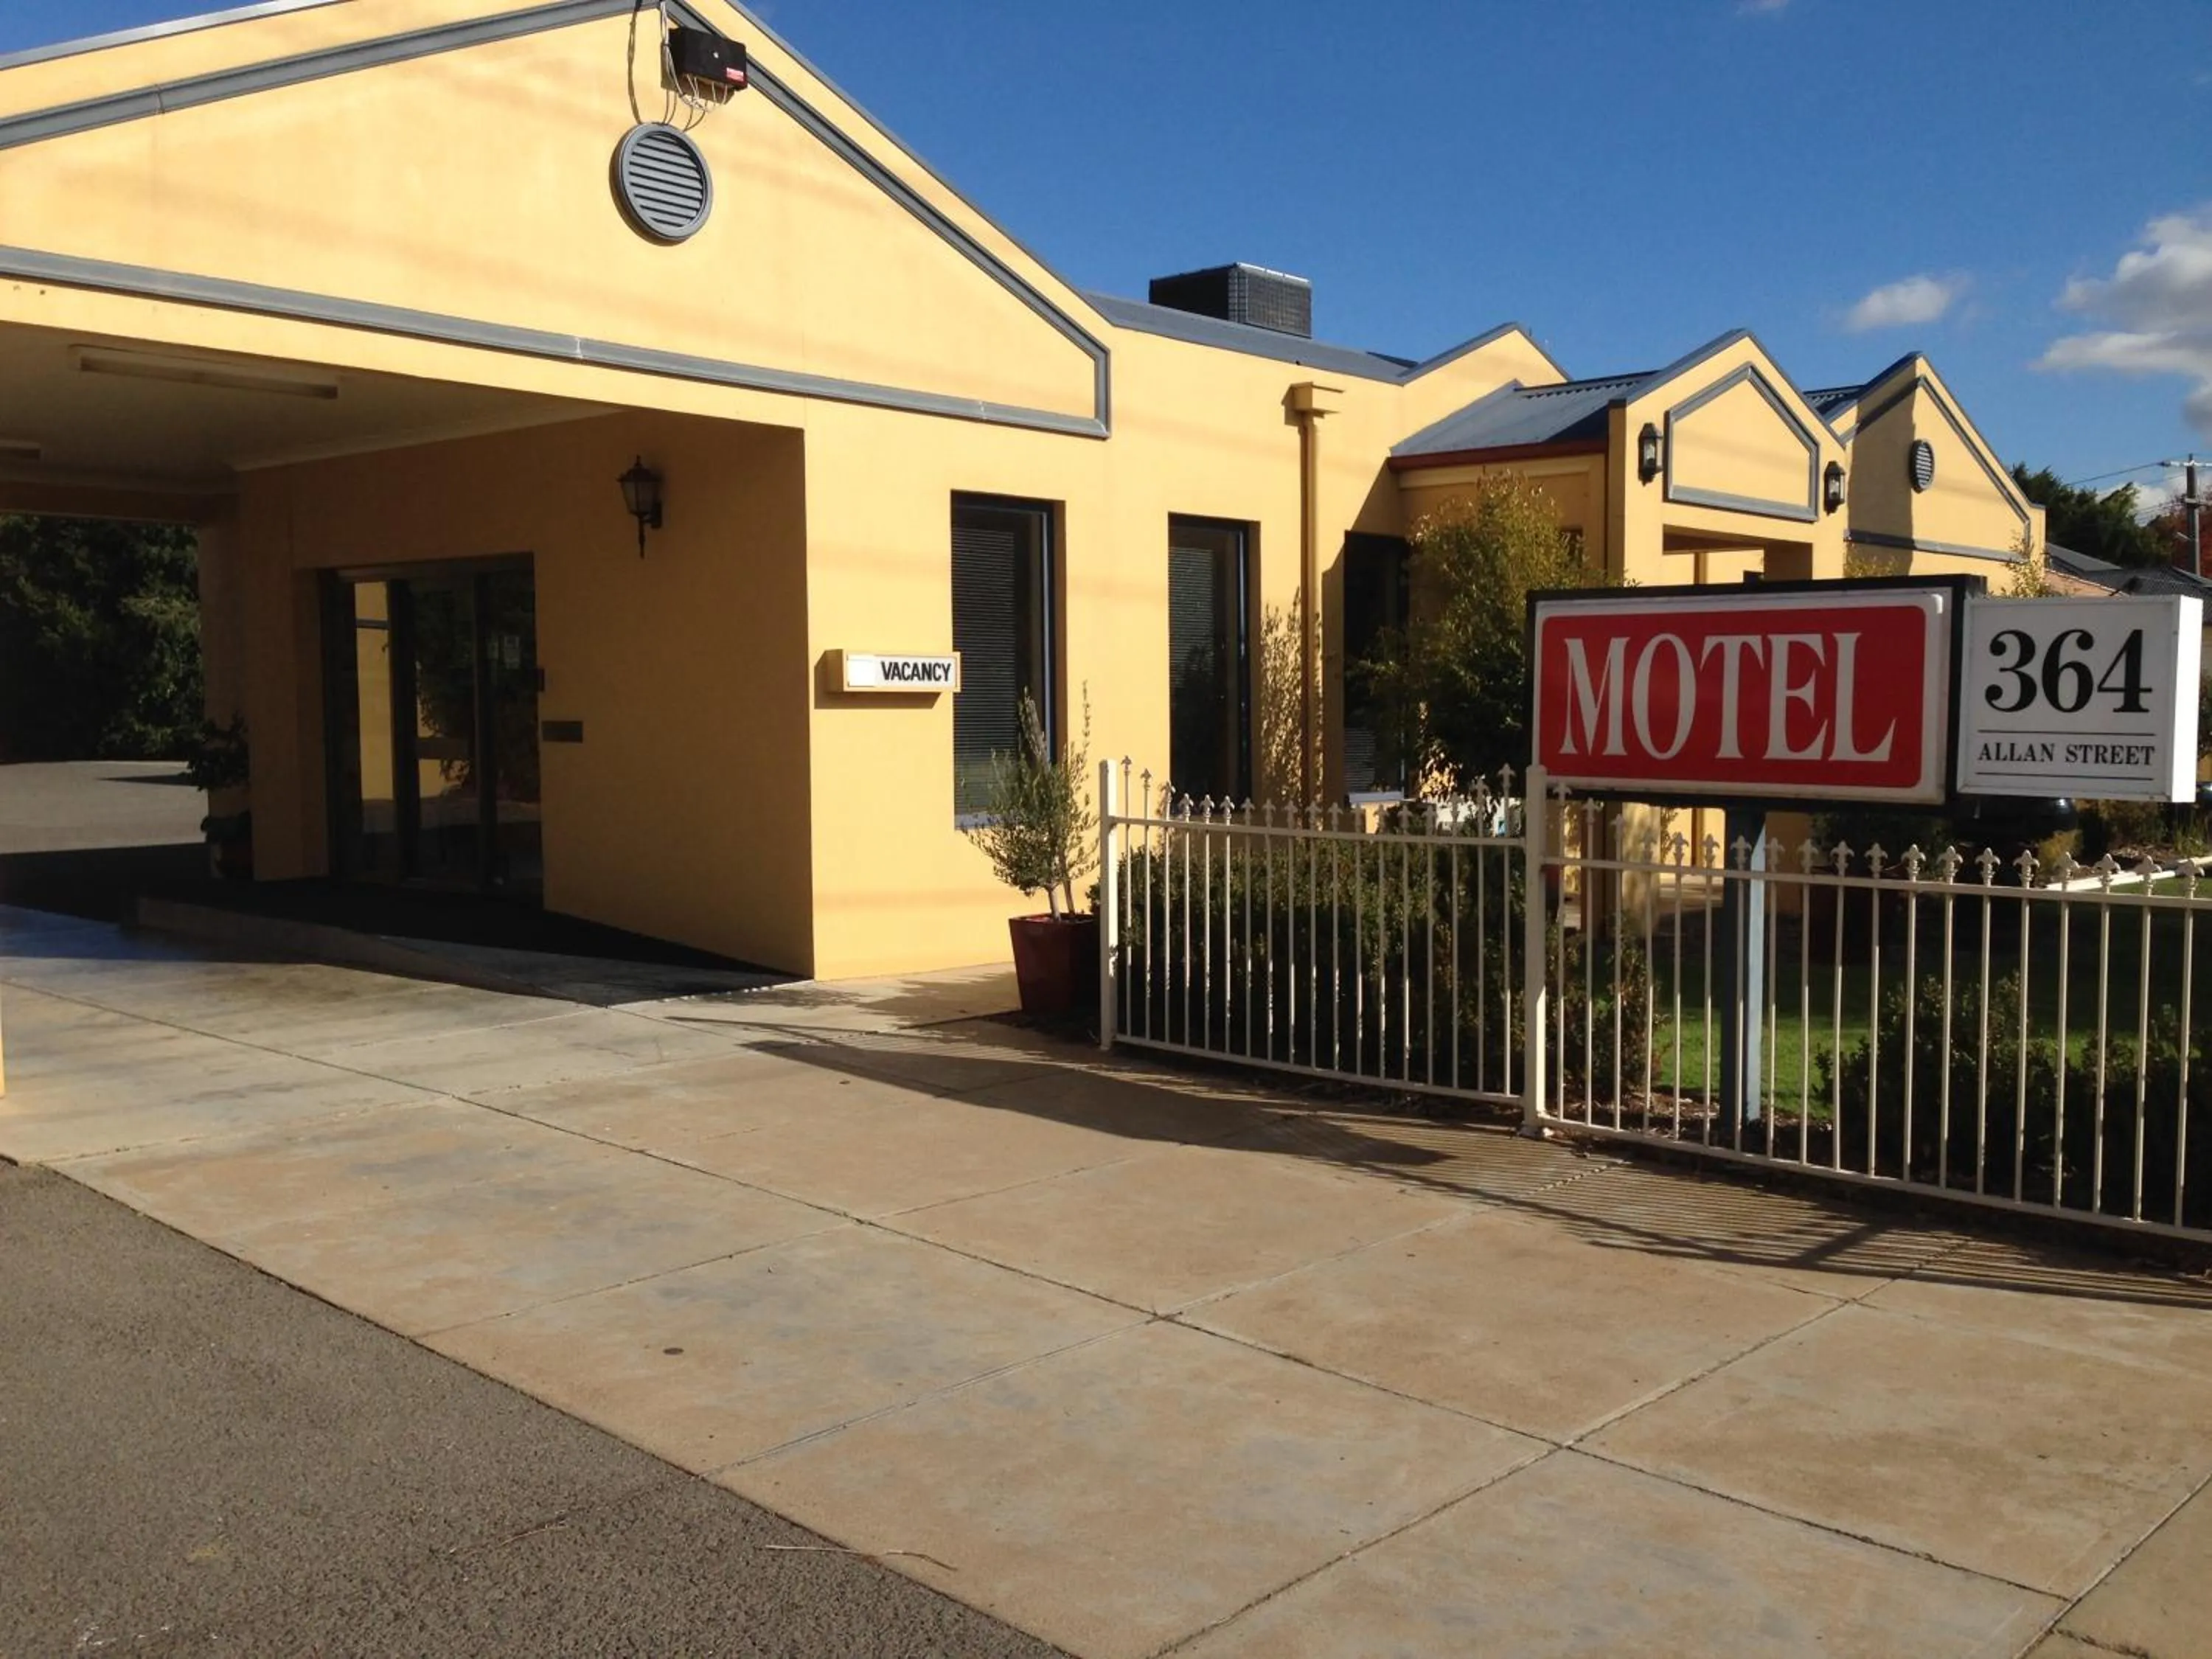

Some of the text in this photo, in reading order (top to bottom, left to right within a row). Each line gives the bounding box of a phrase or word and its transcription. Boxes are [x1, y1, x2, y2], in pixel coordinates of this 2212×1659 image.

[880, 661, 952, 682] VACANCY
[1559, 632, 1897, 762] MOTEL
[1984, 628, 2153, 713] 364
[1978, 742, 2155, 765] ALLAN STREET
